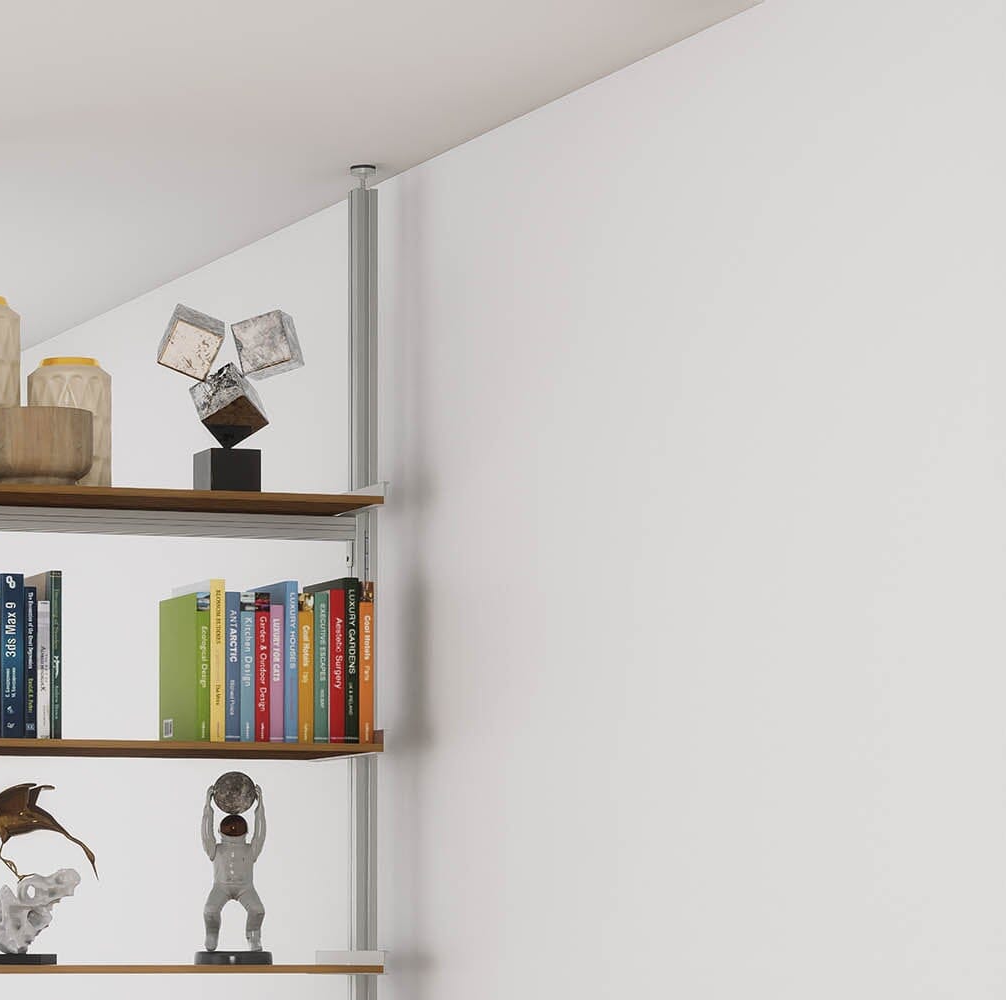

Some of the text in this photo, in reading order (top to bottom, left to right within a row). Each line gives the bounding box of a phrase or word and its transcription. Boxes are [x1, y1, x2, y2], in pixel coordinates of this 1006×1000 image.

[5, 612, 16, 635] Max
[348, 589, 356, 627] LUXURY
[5, 638, 16, 657] 3ds
[200, 626, 208, 661] Ecological
[229, 610, 237, 662] ANTARCTIC
[302, 625, 310, 667] Cool Hotels
[242, 656, 252, 687] Design
[334, 655, 342, 689] Surgery
[258, 687, 267, 711] Design
